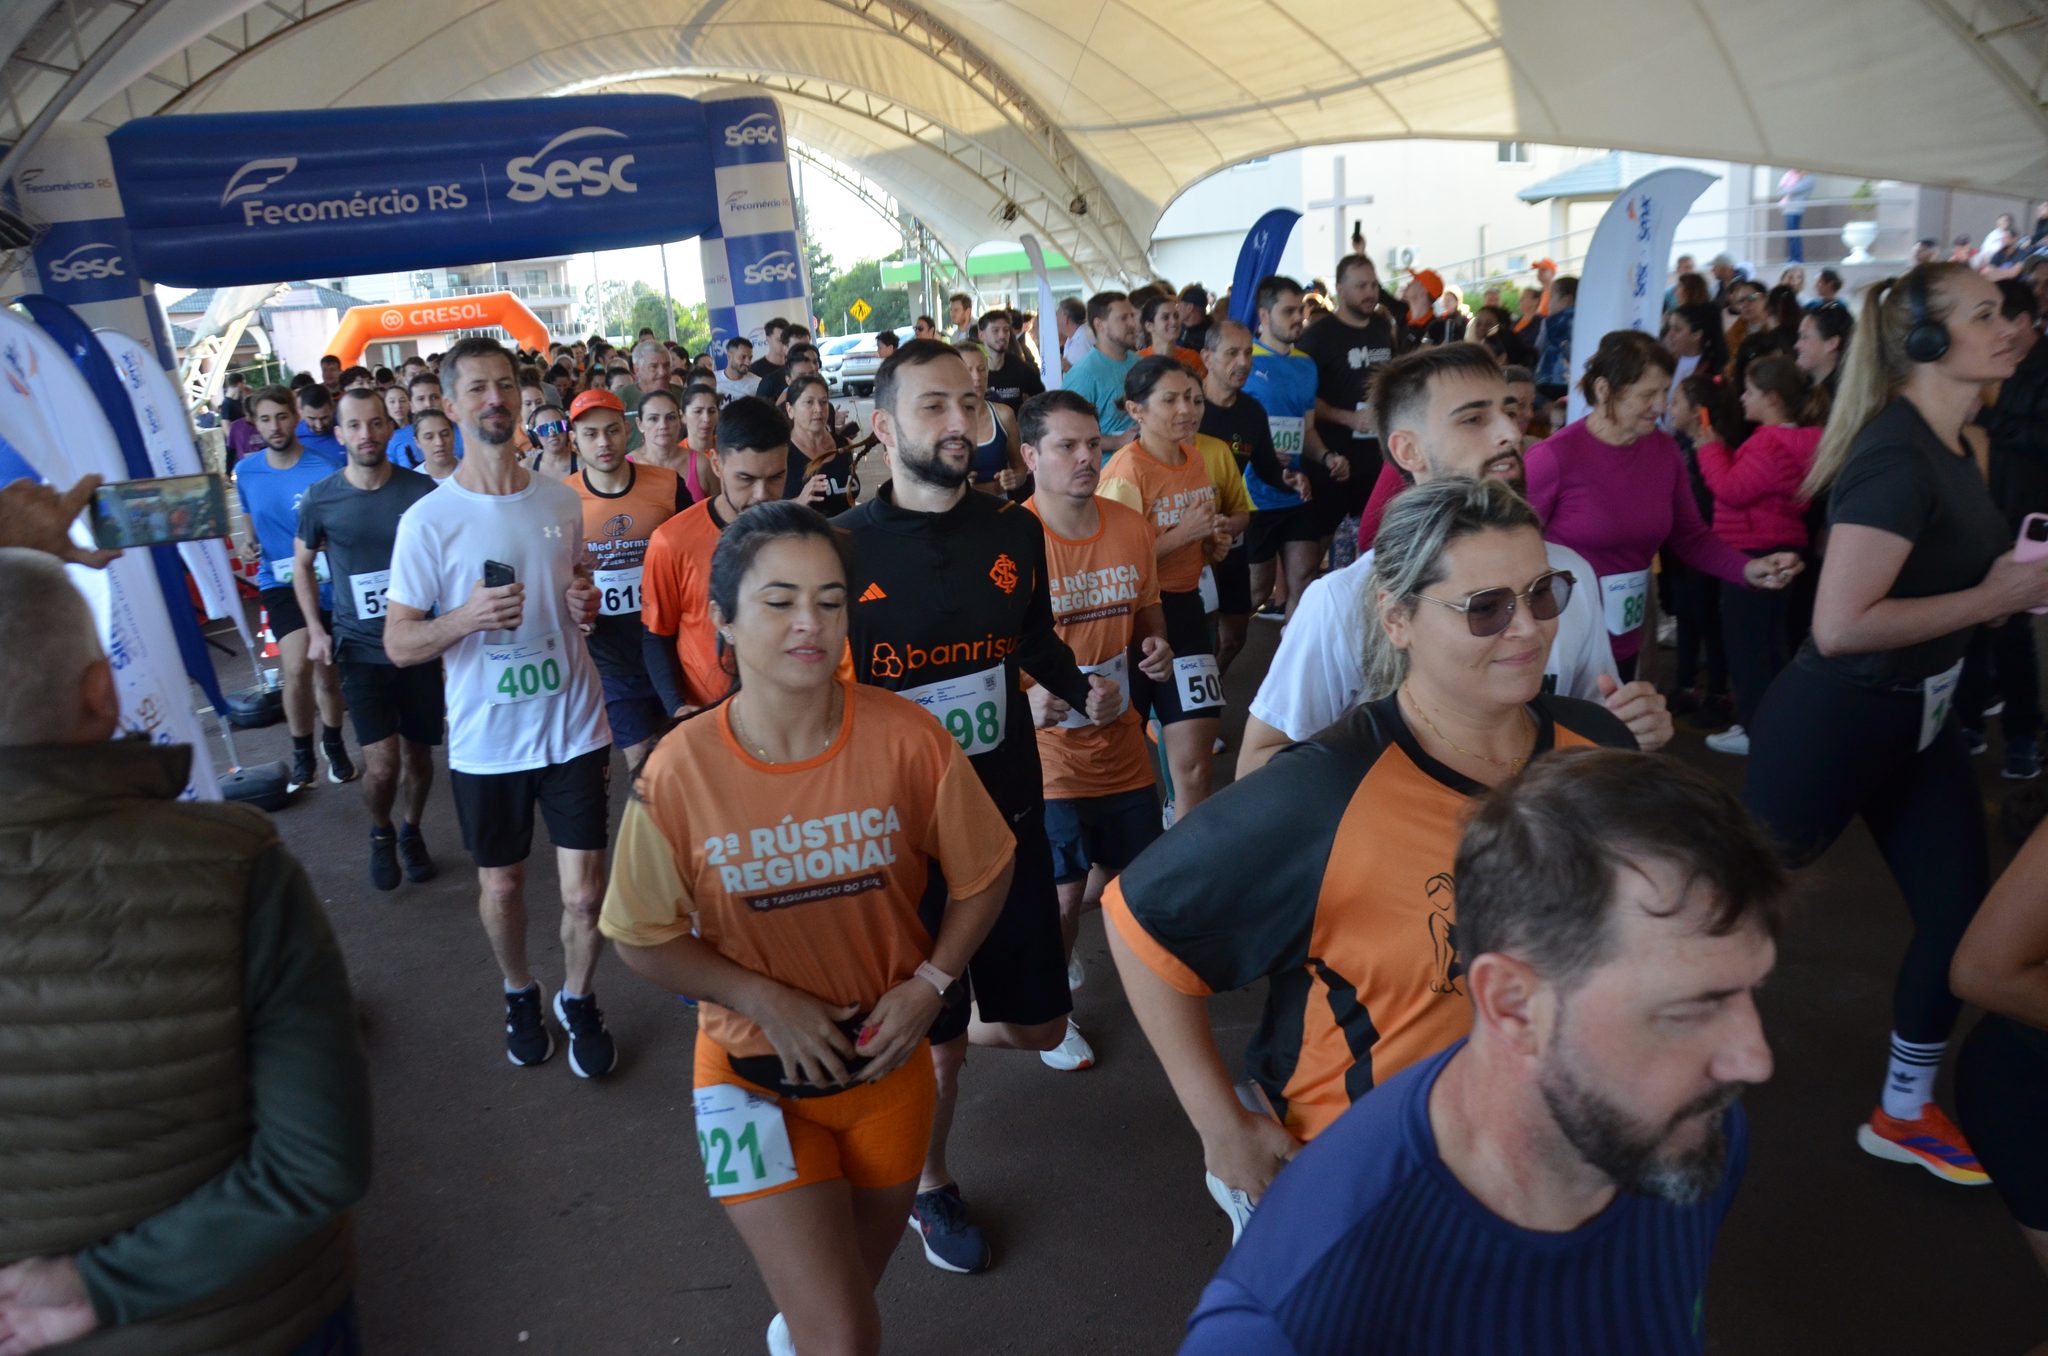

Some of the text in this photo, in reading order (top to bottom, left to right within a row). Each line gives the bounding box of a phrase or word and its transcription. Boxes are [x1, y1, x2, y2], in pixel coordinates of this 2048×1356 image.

[725, 125, 778, 147] Sesc
[24, 178, 112, 193] Fecomércio RS
[506, 153, 638, 203] Sesc
[242, 183, 468, 226] Fecomércio RS
[49, 256, 126, 282] Sesc
[744, 262, 797, 285] Sesc
[409, 303, 488, 325] CRESOL
[1273, 430, 1301, 451] 405
[587, 541, 612, 552] Med
[1063, 564, 1139, 593] RÚSTICA
[1051, 582, 1138, 612] REGIONAL
[906, 633, 1018, 669] banrisu
[497, 657, 560, 698] 400
[1189, 673, 1225, 703] 50
[936, 701, 999, 750] 98
[704, 805, 901, 865] 2ª RÚSTICA
[720, 837, 896, 894] REGIONAL
[843, 882, 859, 892] DO
[862, 878, 881, 888] SUL
